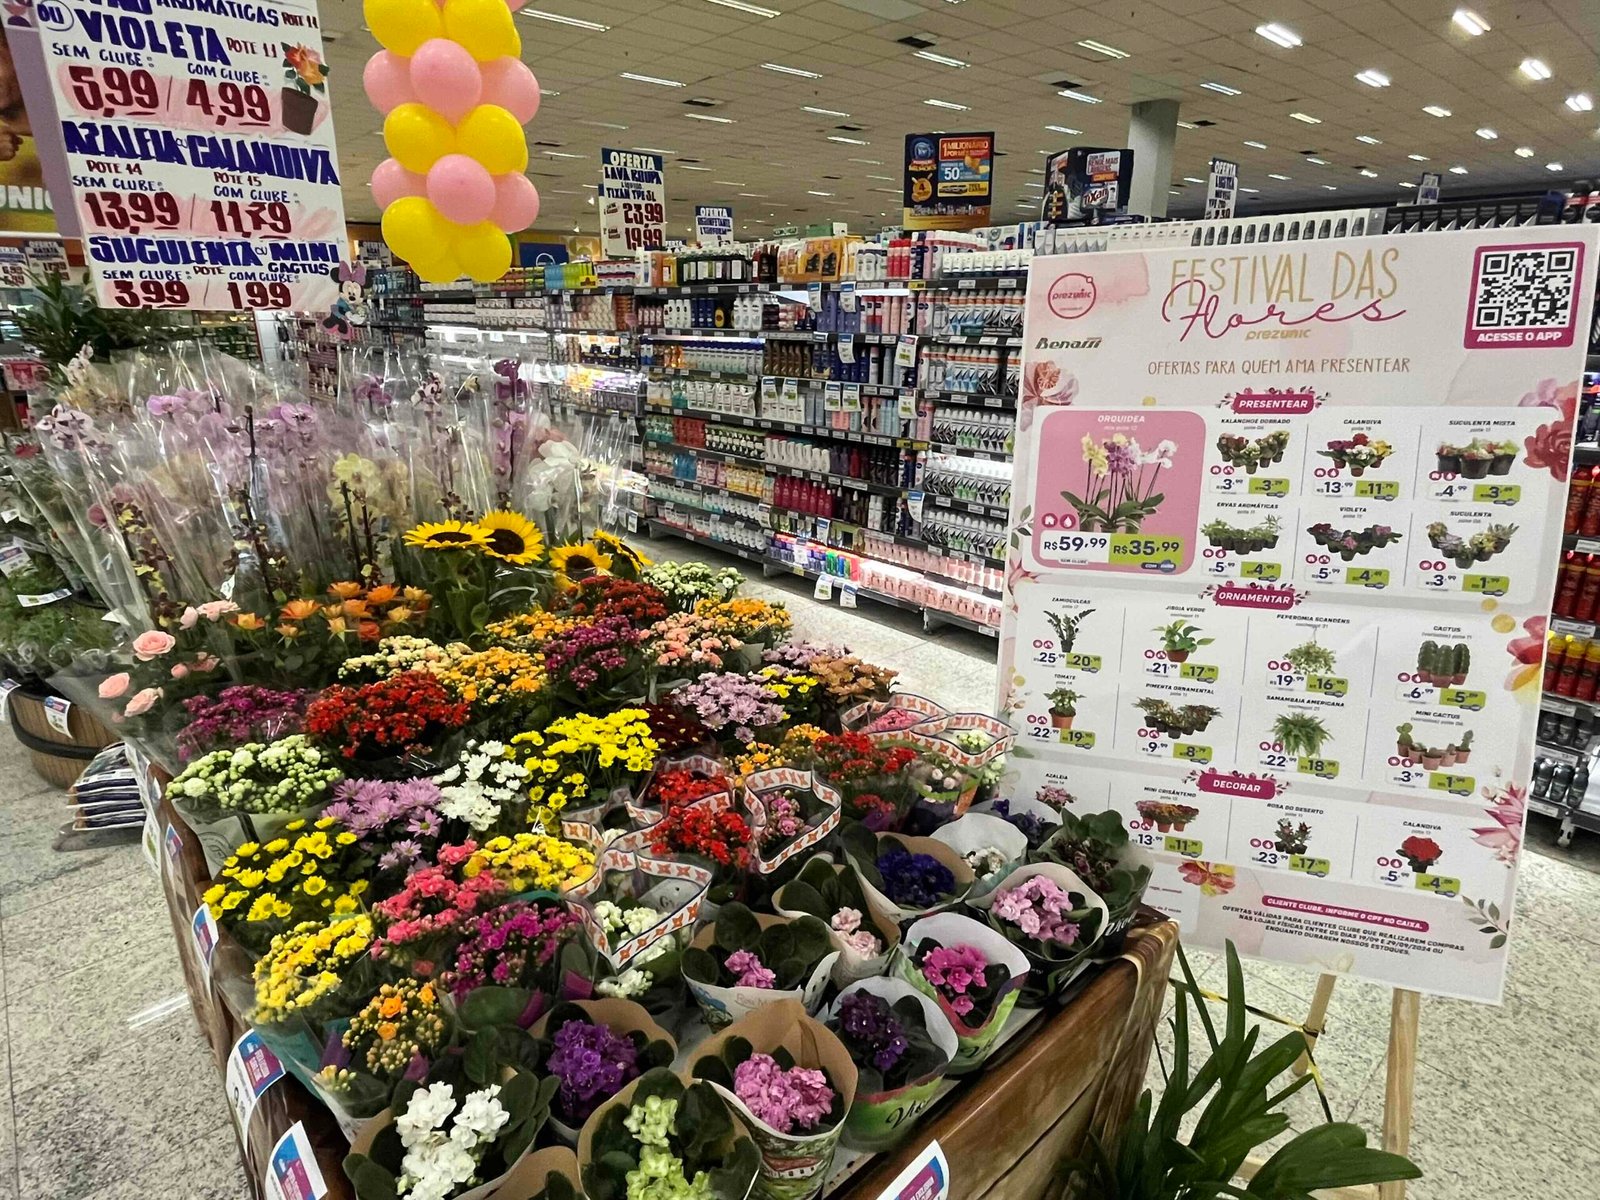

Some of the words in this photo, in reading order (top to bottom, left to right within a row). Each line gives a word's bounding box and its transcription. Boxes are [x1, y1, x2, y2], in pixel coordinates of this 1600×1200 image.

[37, 4, 64, 24] OU
[74, 9, 231, 66] VIOLETA
[226, 37, 256, 54] POTE
[52, 42, 90, 59] SEM
[187, 62, 217, 78] COM
[69, 66, 159, 117] 5,99
[186, 78, 271, 126] 4,99
[86, 160, 122, 174] POTE
[187, 135, 341, 186] CALANDIVA
[610, 151, 655, 171] OFERTA
[213, 172, 244, 185] POTE
[247, 175, 263, 186] 15
[604, 167, 630, 181] LAVA
[944, 167, 960, 180] 50
[73, 175, 106, 188] SEM
[214, 186, 244, 198] COM
[85, 192, 180, 235] 13,99
[700, 207, 728, 217] OFERTA
[211, 201, 291, 238] 11,79
[89, 236, 263, 266] SUCULENTA
[268, 243, 339, 263] MINI
[103, 270, 134, 279] SEM
[193, 266, 225, 275] POTE
[229, 271, 256, 281] COM
[268, 262, 329, 276] CACTUS
[1169, 253, 1315, 307] FESTIVAL
[1331, 247, 1399, 299] DAS
[1162, 280, 1406, 342] Flores
[1245, 328, 1311, 341] prezunic
[1477, 332, 1523, 342] ACESSE
[1525, 332, 1534, 341] O
[1537, 331, 1562, 341] APP
[1148, 361, 1200, 375] OFERTAS
[1205, 360, 1235, 374] PARA
[1241, 360, 1280, 375] QUEM
[1285, 359, 1314, 374] AMA
[1320, 358, 1410, 373] PRESENTEAR
[1239, 400, 1308, 409] PRESENTEAR
[1098, 415, 1145, 423] ORQUIDEA
[1219, 591, 1291, 604] ORNAMENTAR
[1213, 779, 1261, 793] DECORAR
[1295, 806, 1324, 814] DESERTO
[1403, 821, 1441, 830] CALANDIVA
[1267, 898, 1298, 908] CLIENTE
[1325, 908, 1359, 918] INFORME
[1222, 905, 1251, 914] OFERTAS
[1253, 910, 1282, 920] VÁLIDAS
[1283, 915, 1302, 923] PARA
[1303, 919, 1336, 929] CLIENTES
[1338, 924, 1360, 933] CLUBE
[1379, 932, 1426, 944] REALIZAREM
[1427, 941, 1465, 951] COMPRAS
[1254, 917, 1276, 925] LOJAS
[1305, 926, 1329, 934] ENTRE
[1265, 925, 1303, 936] ENQUANTO
[1304, 931, 1339, 941] DURAREM
[1340, 938, 1370, 948] NOSSOS
